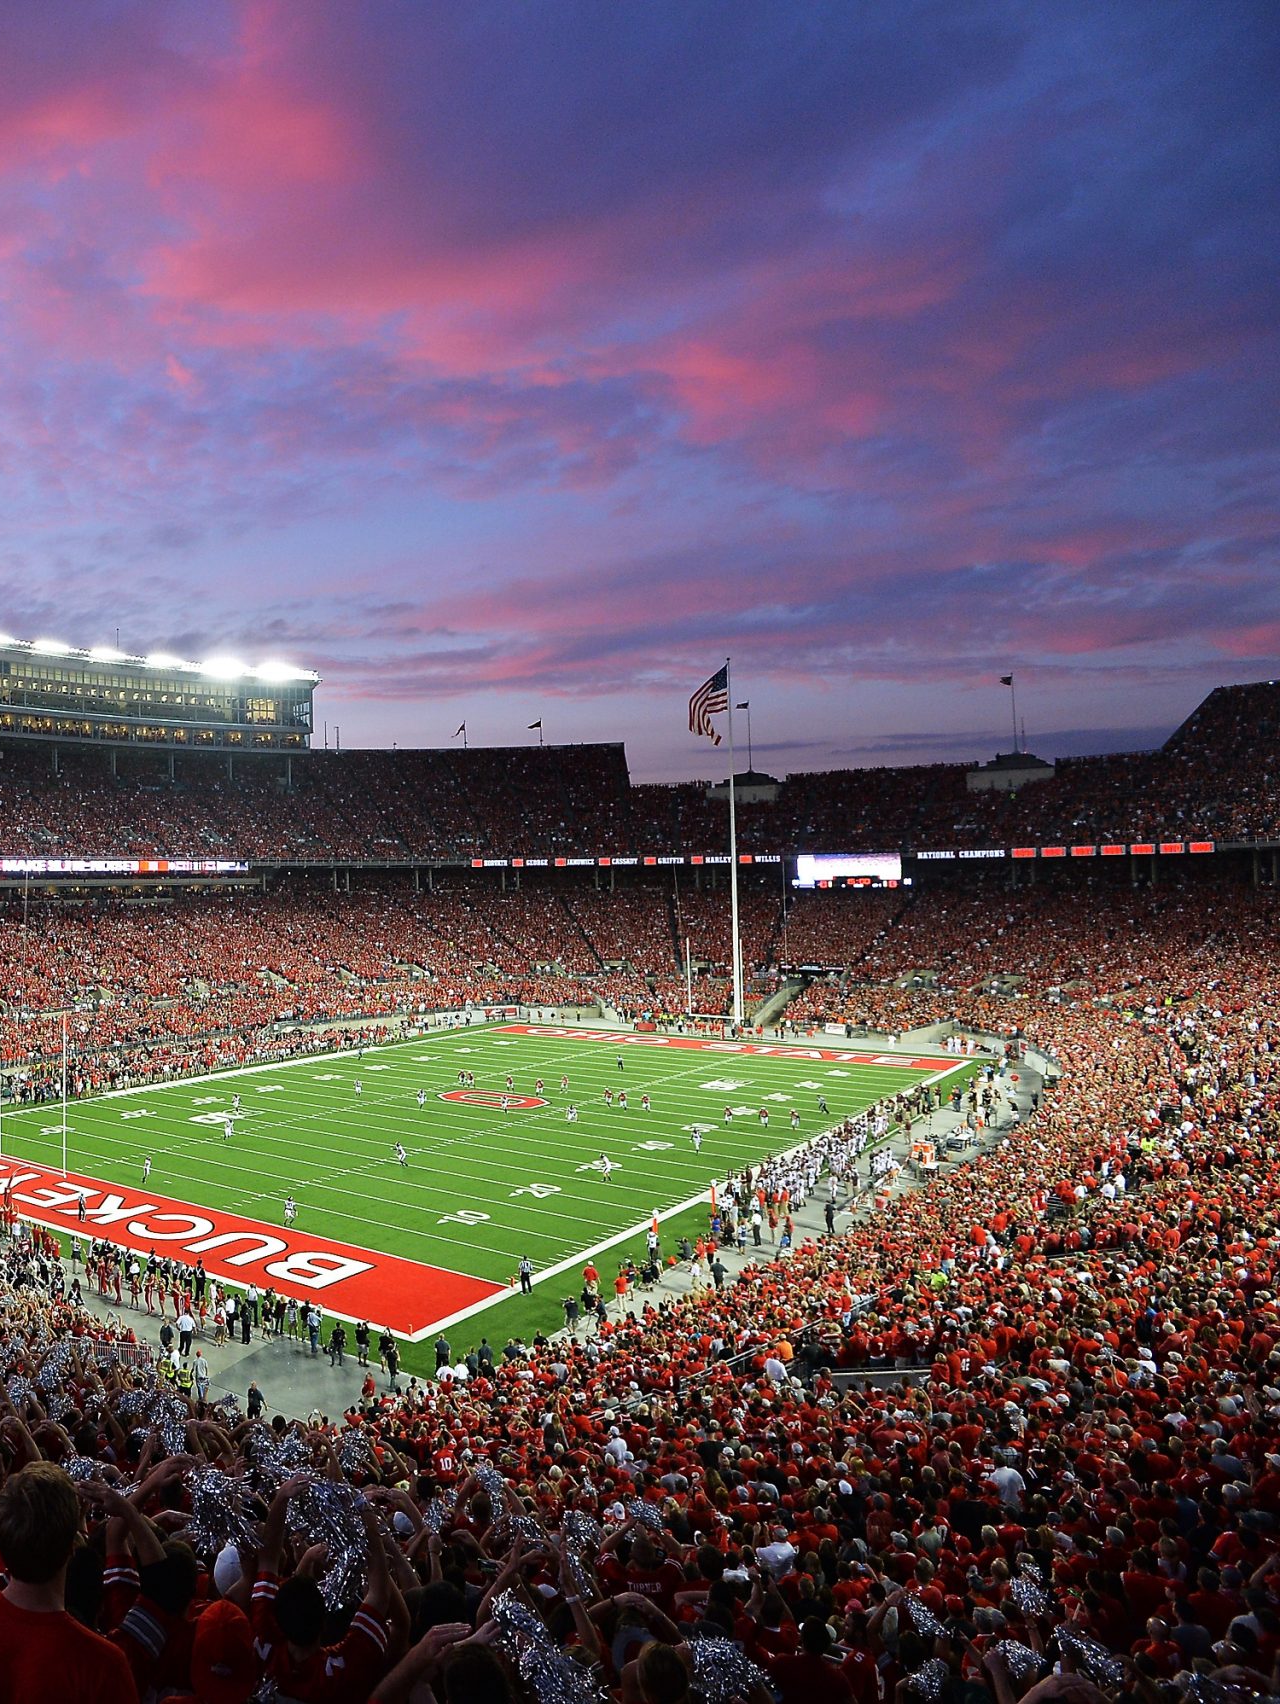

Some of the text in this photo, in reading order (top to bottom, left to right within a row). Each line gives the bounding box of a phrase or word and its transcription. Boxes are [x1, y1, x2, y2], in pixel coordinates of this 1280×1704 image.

[657, 857, 685, 865] GRIFFIN
[754, 855, 781, 863] WILLIS
[917, 851, 956, 859] NATIONAL
[958, 850, 1005, 858] CHAMPIONS
[525, 1027, 913, 1067] OHIO STATE
[517, 1182, 562, 1199] 20
[442, 1209, 491, 1226] 10
[439, 1457, 452, 1471] 10
[626, 1580, 665, 1594] TURNER
